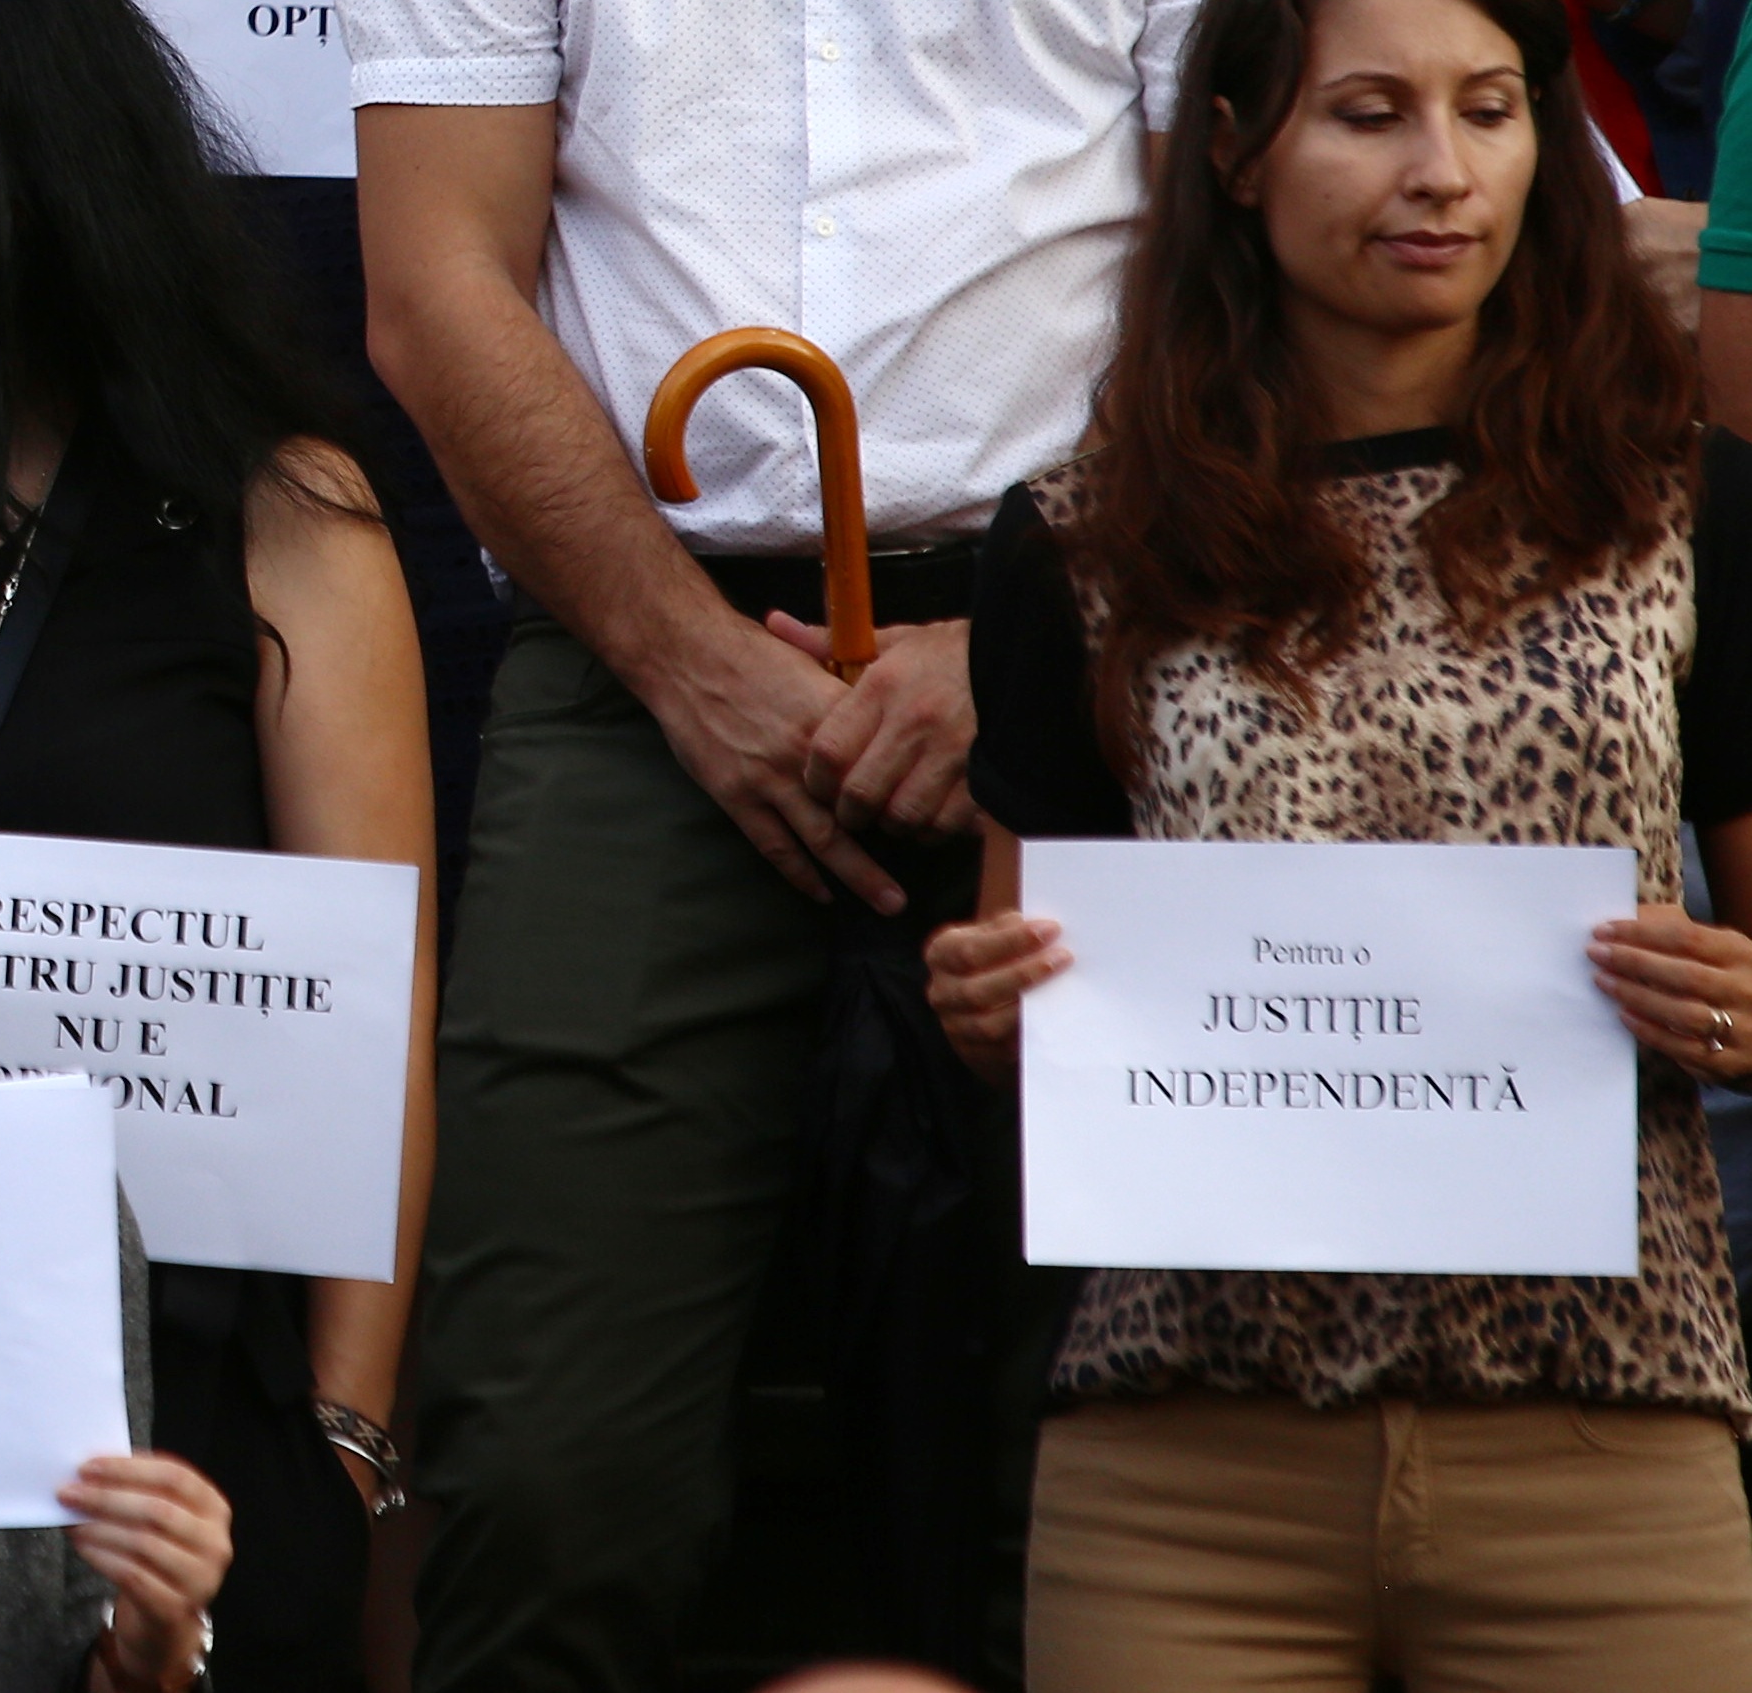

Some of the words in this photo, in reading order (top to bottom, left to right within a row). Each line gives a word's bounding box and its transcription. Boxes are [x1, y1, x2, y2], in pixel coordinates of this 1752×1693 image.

[1252, 936, 1344, 965] Pentru
[1352, 946, 1371, 965] o
[109, 963, 331, 1017] JUSTIȚIE
[55, 1013, 122, 1052] NU
[139, 1019, 166, 1056] E
[1203, 993, 1421, 1043] JUSTIȚIE
[1128, 1065, 1526, 1111] INDEPENDENTĂ
